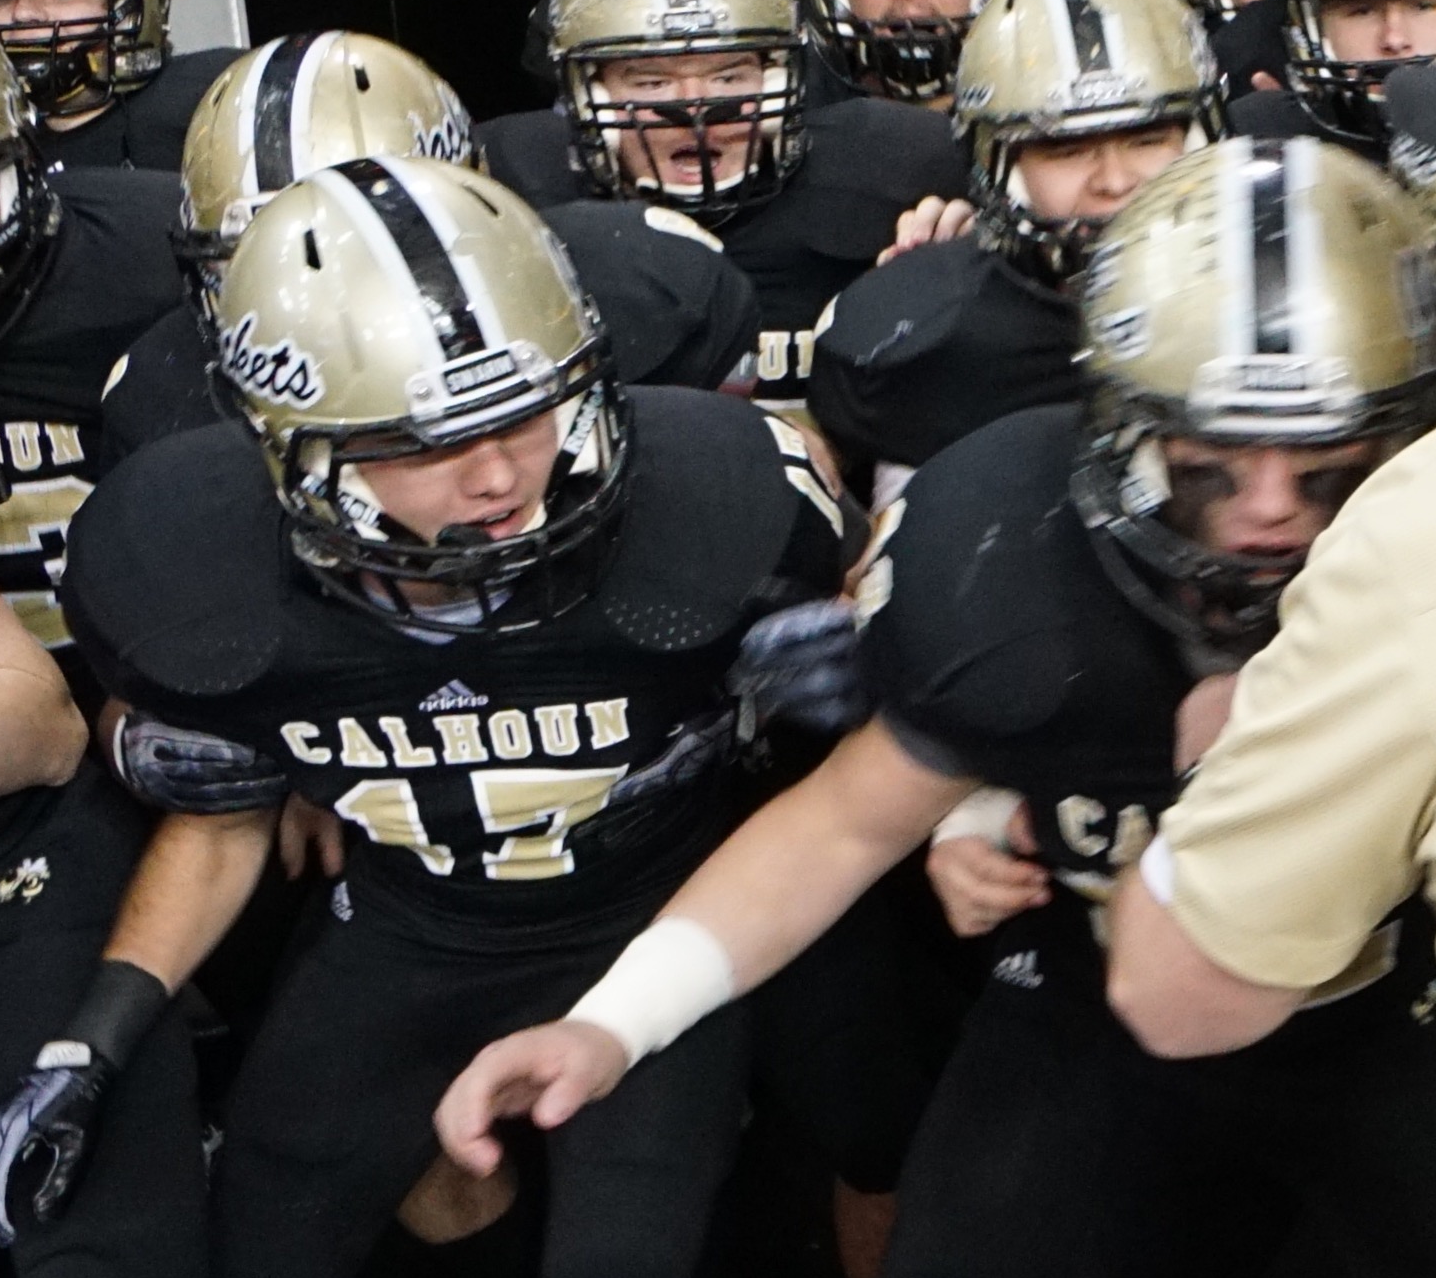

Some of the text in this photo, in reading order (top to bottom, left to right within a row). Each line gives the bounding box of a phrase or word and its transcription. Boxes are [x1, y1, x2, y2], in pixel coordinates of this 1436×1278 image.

[280, 698, 631, 769] CALHOUN
[418, 695, 490, 714] adidas
[333, 763, 630, 881] 17
